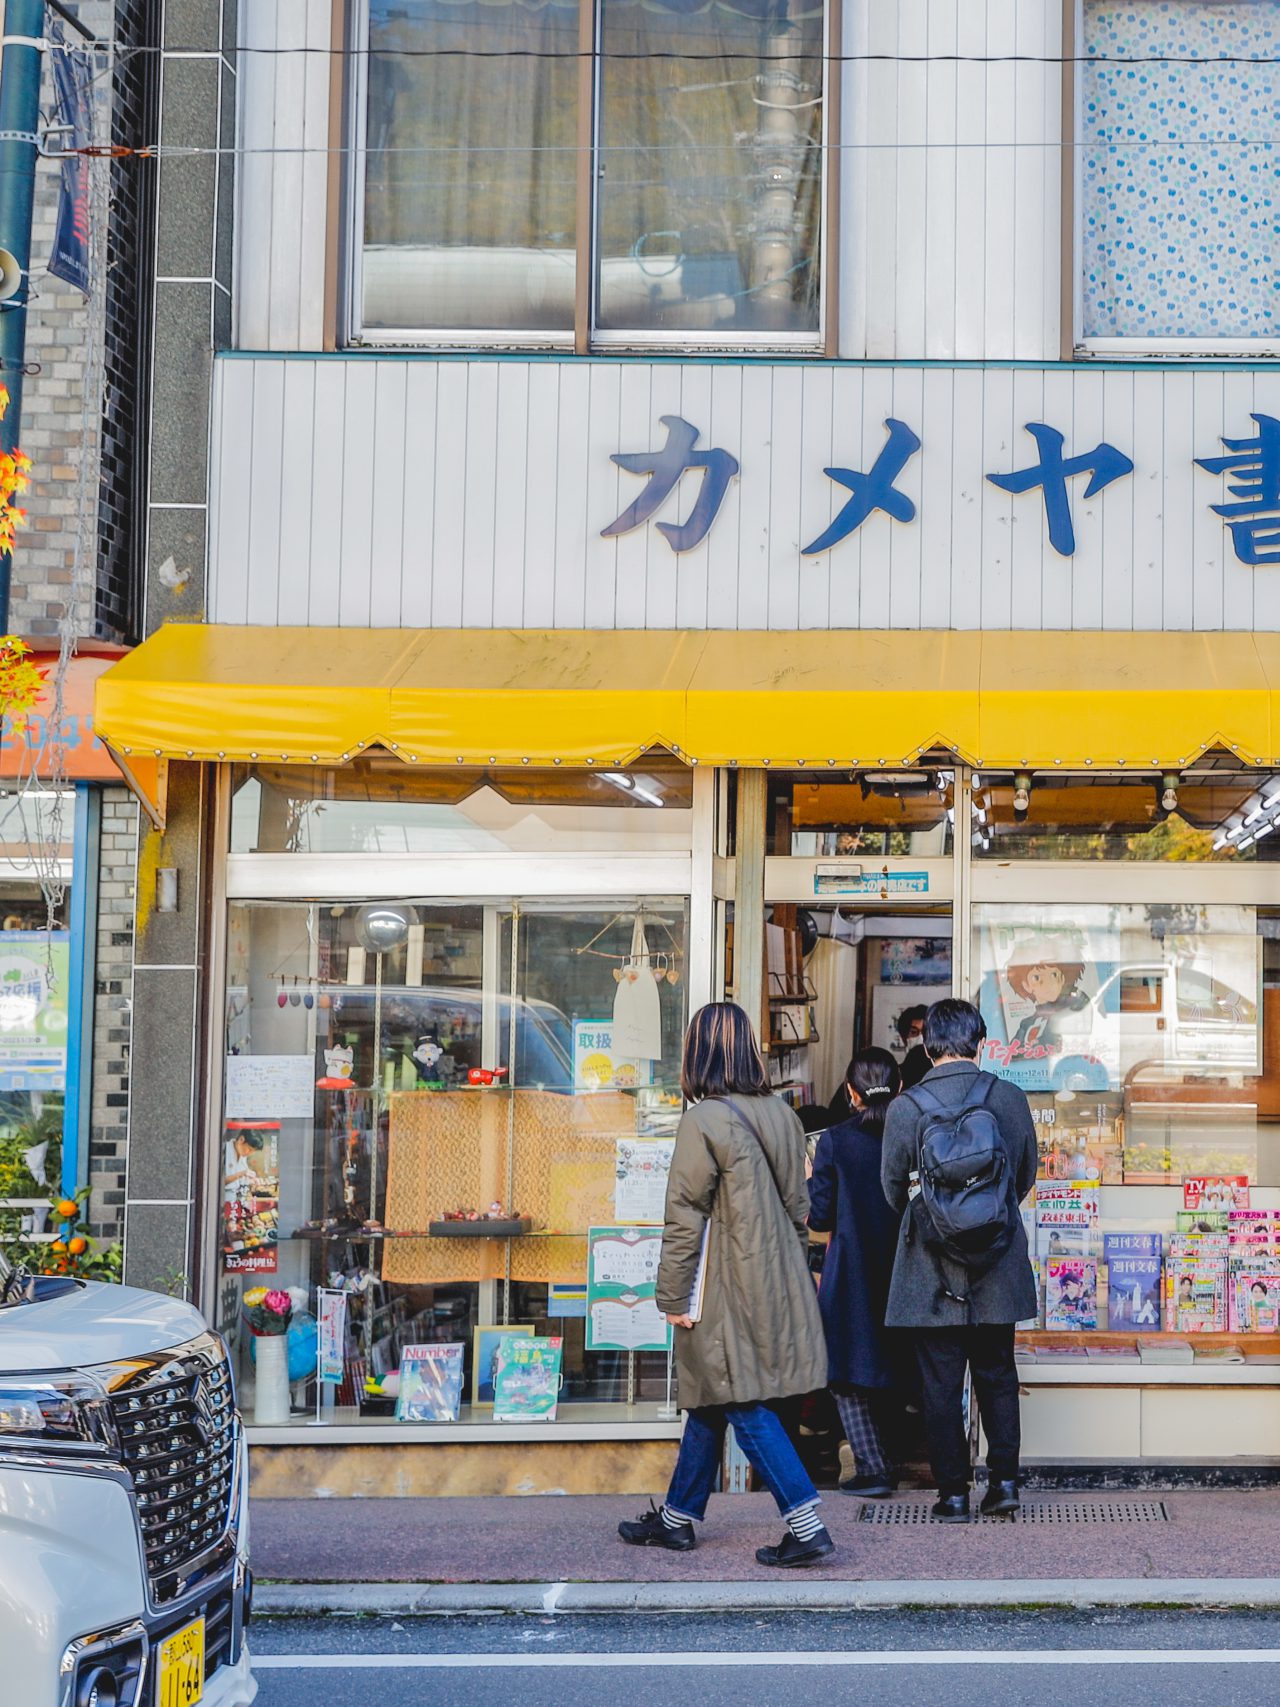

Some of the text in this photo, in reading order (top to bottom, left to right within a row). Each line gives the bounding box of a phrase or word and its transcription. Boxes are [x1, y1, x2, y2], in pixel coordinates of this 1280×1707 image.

[1041, 1212, 1087, 1223] 政経東北
[1107, 1236, 1153, 1249] 週刊文春
[1112, 1260, 1158, 1273] 週刊文春
[405, 1347, 460, 1360] Number
